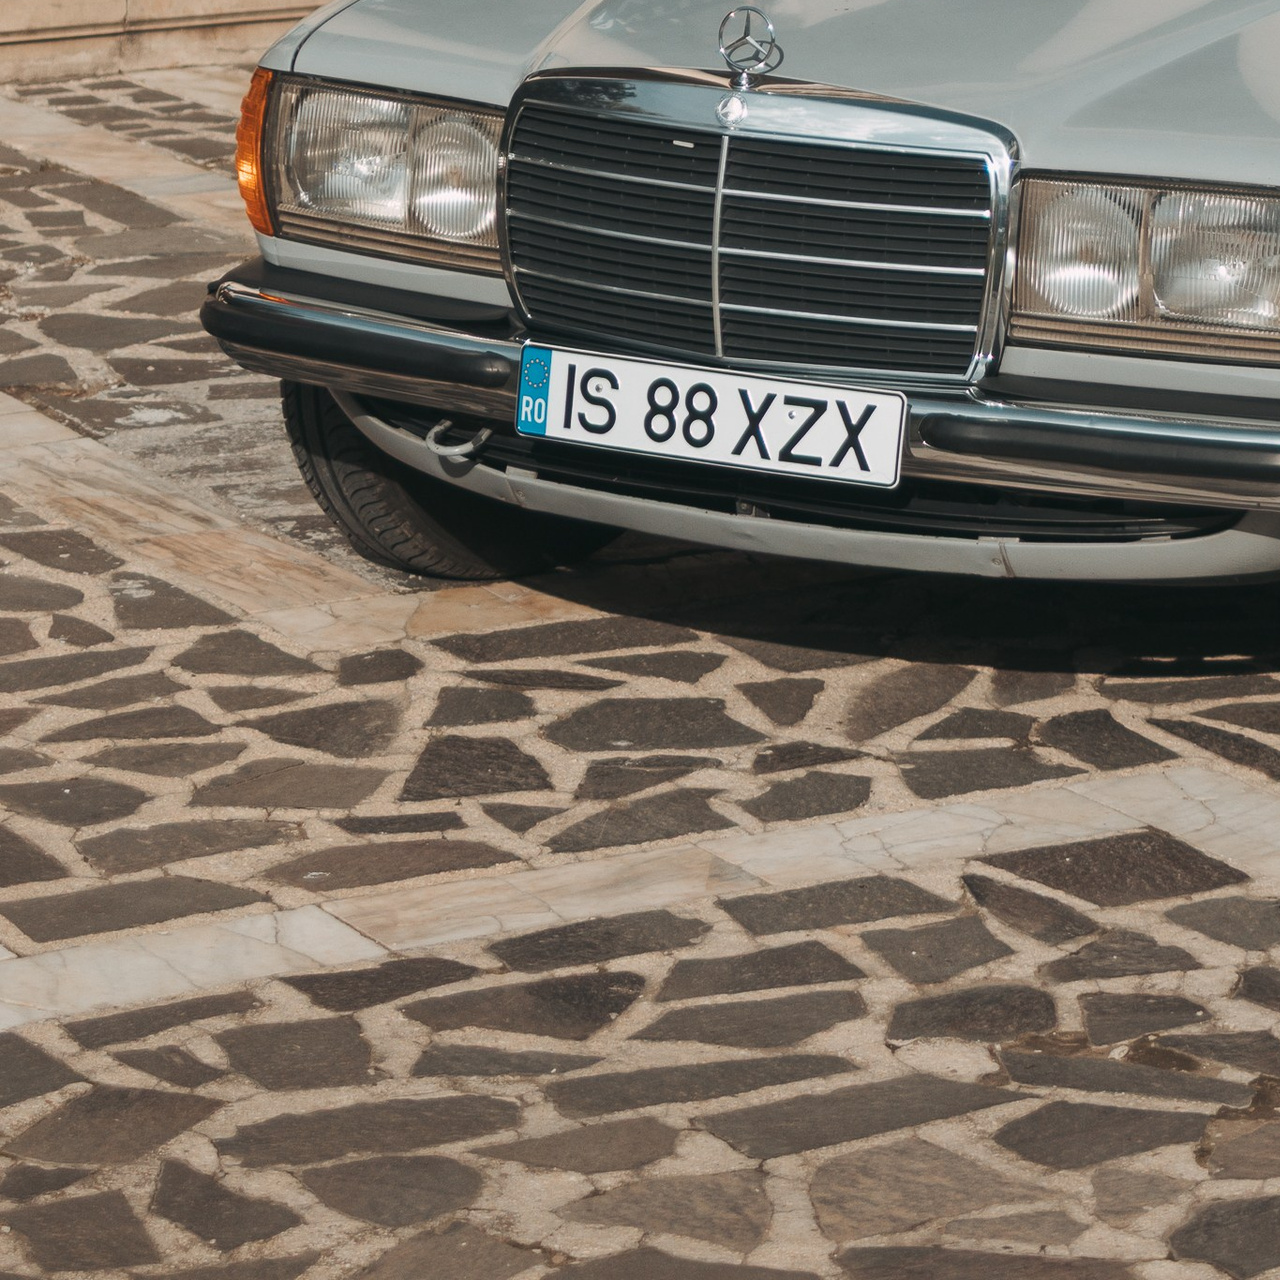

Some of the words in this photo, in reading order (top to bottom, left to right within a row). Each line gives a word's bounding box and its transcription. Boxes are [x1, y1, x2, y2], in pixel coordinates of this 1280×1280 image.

[521, 394, 546, 424] RO
[563, 363, 619, 435] IS
[644, 377, 718, 448] 88
[731, 388, 877, 472] XZX
